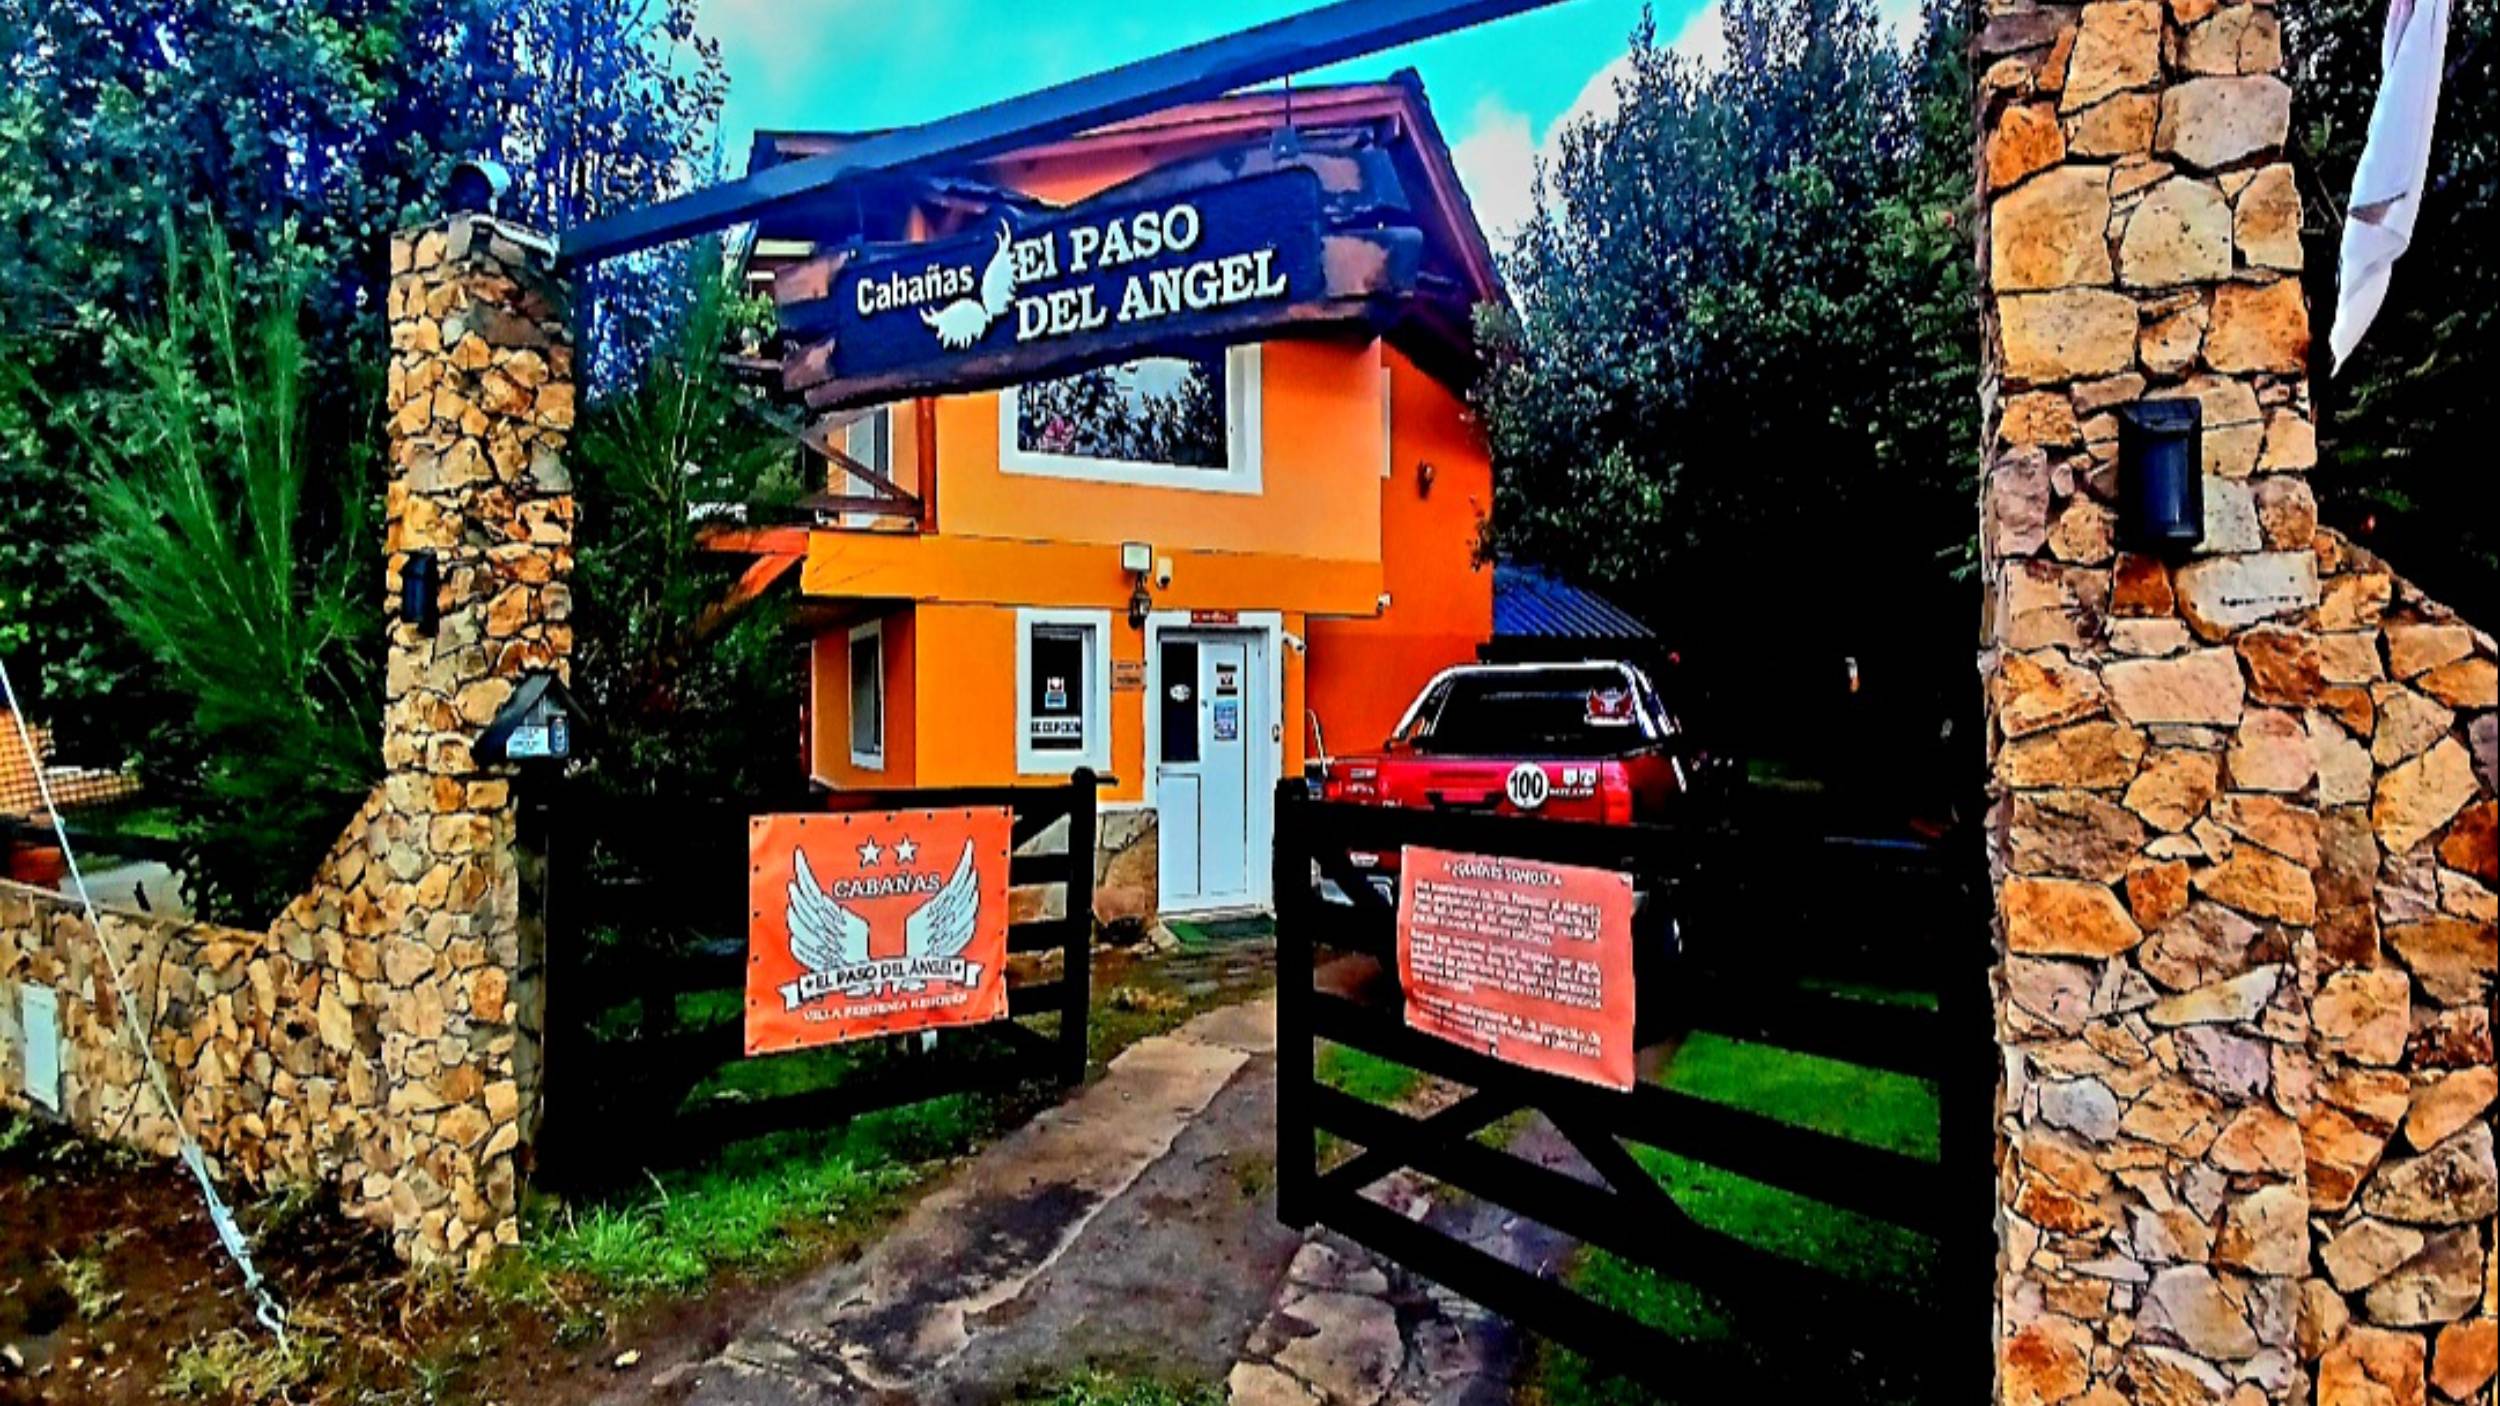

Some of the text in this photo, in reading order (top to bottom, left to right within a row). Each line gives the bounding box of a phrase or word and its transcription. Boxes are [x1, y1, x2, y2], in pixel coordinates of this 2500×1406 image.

[1069, 203, 1200, 273] PASO
[857, 262, 975, 316] Cabañas
[1015, 249, 1287, 341] DEL ANGEL
[1509, 770, 1544, 800] 100
[834, 871, 941, 897] CABAÑAS
[815, 973, 832, 989] EL
[837, 964, 877, 987] PASO
[881, 962, 905, 980] DEL
